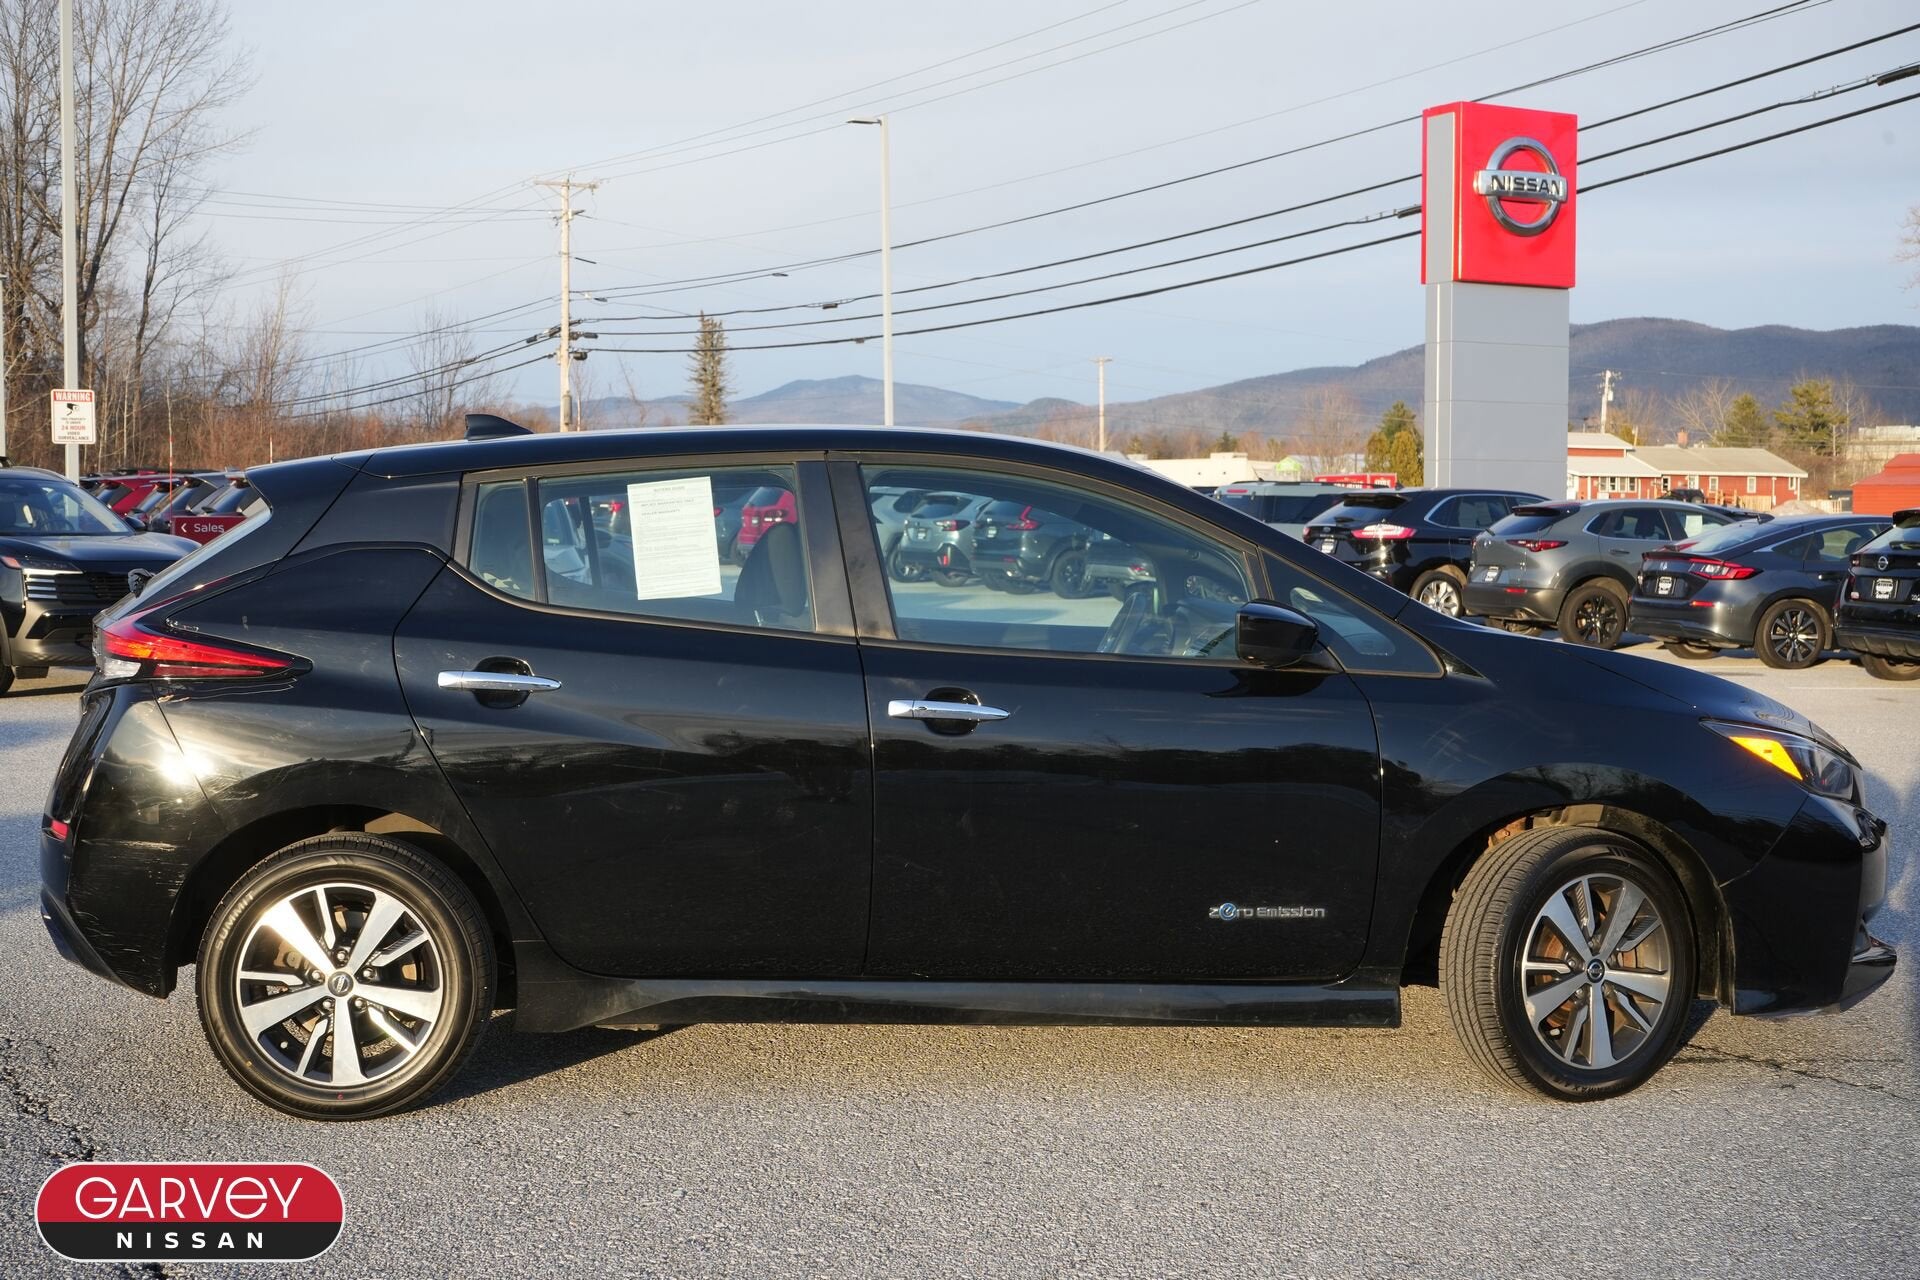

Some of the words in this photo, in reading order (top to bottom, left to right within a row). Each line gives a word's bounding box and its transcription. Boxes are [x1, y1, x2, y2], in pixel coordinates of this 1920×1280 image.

[1490, 174, 1562, 197] NISSAN
[56, 391, 91, 402] WARNING
[193, 523, 225, 533] Sales
[1256, 905, 1326, 918] Emission
